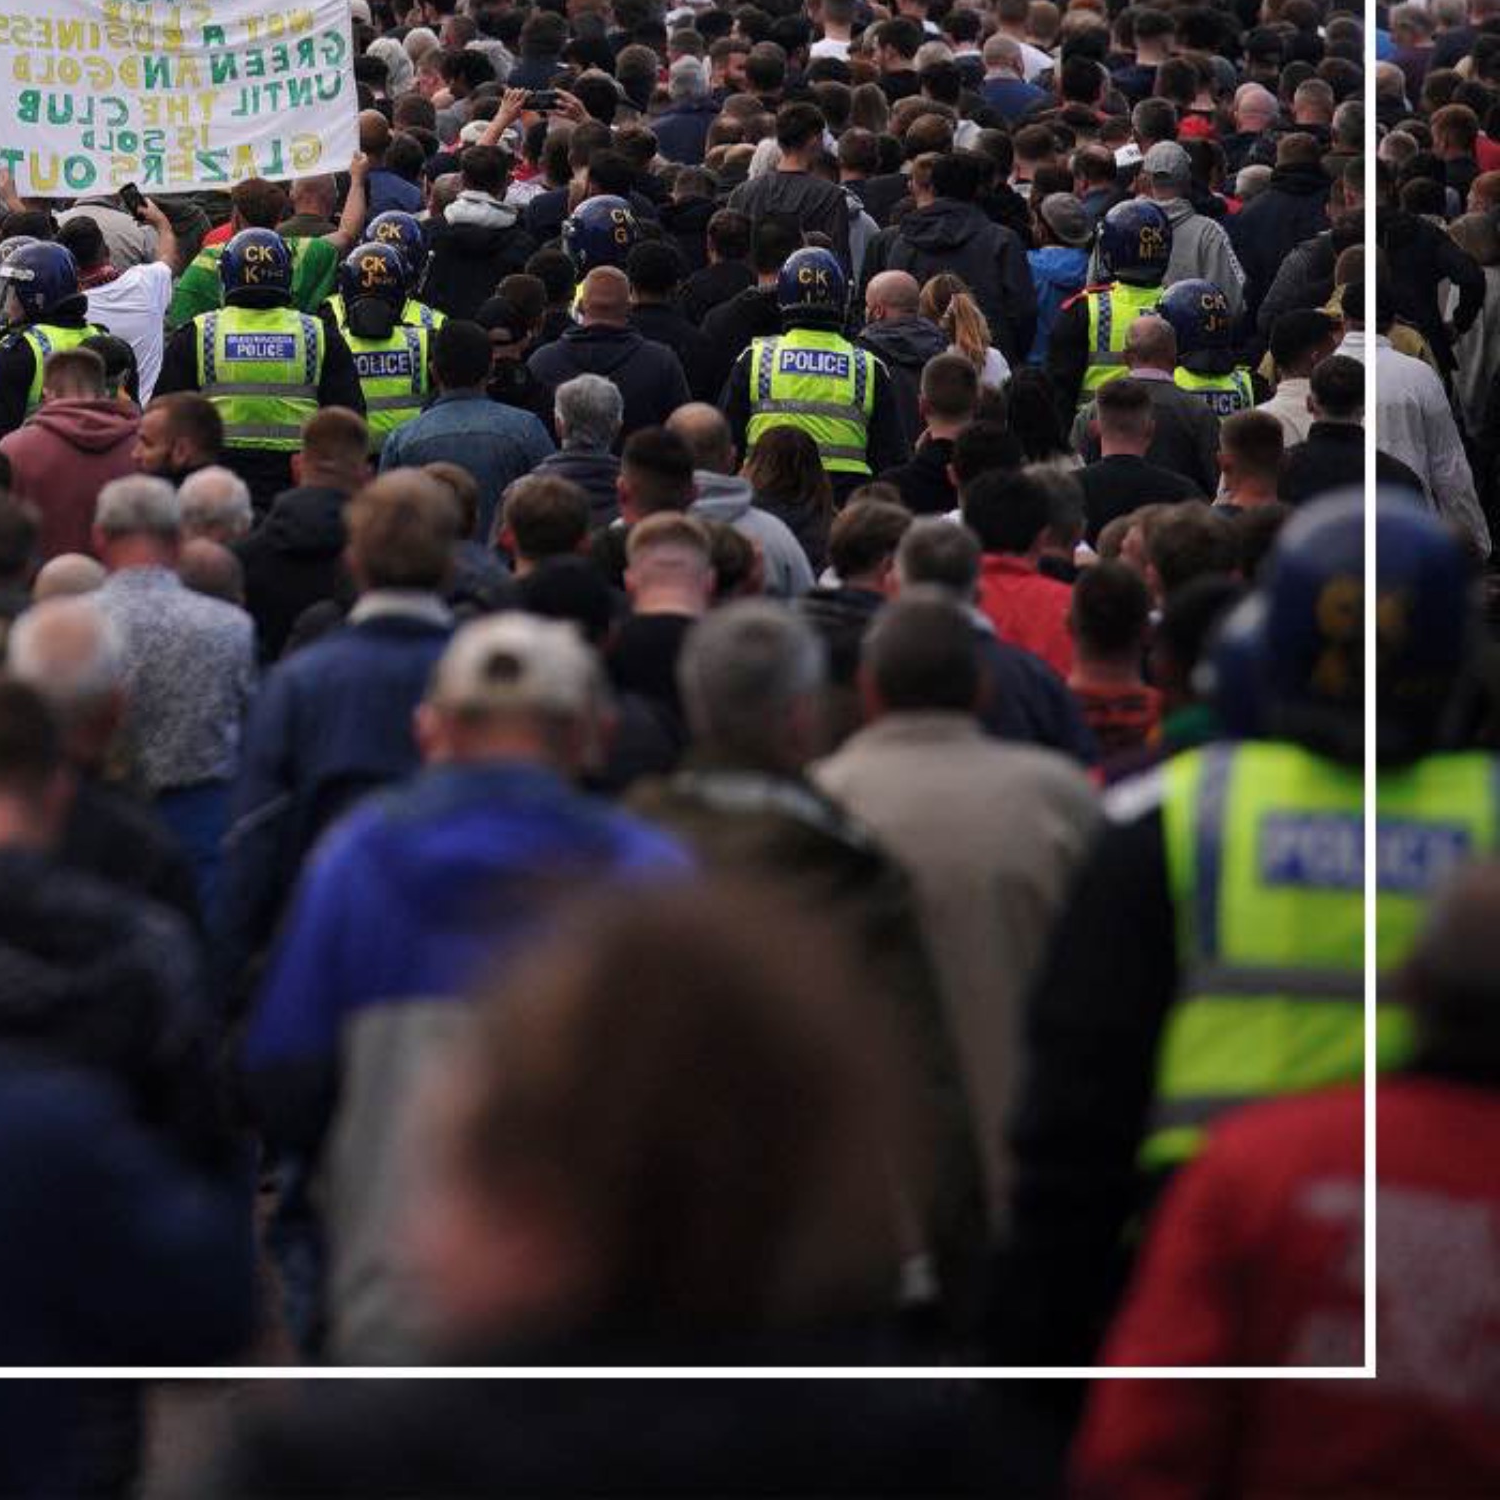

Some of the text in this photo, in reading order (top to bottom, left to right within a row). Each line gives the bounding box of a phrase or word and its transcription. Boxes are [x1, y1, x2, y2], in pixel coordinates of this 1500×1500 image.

[376, 223, 404, 239] CK
[1140, 227, 1163, 243] CK
[245, 245, 274, 263] CK
[361, 256, 387, 274] CK
[245, 266, 259, 283] K
[362, 273, 373, 287] J
[798, 267, 828, 285] CK
[236, 344, 285, 357] POLICE
[782, 351, 848, 374] POLICE
